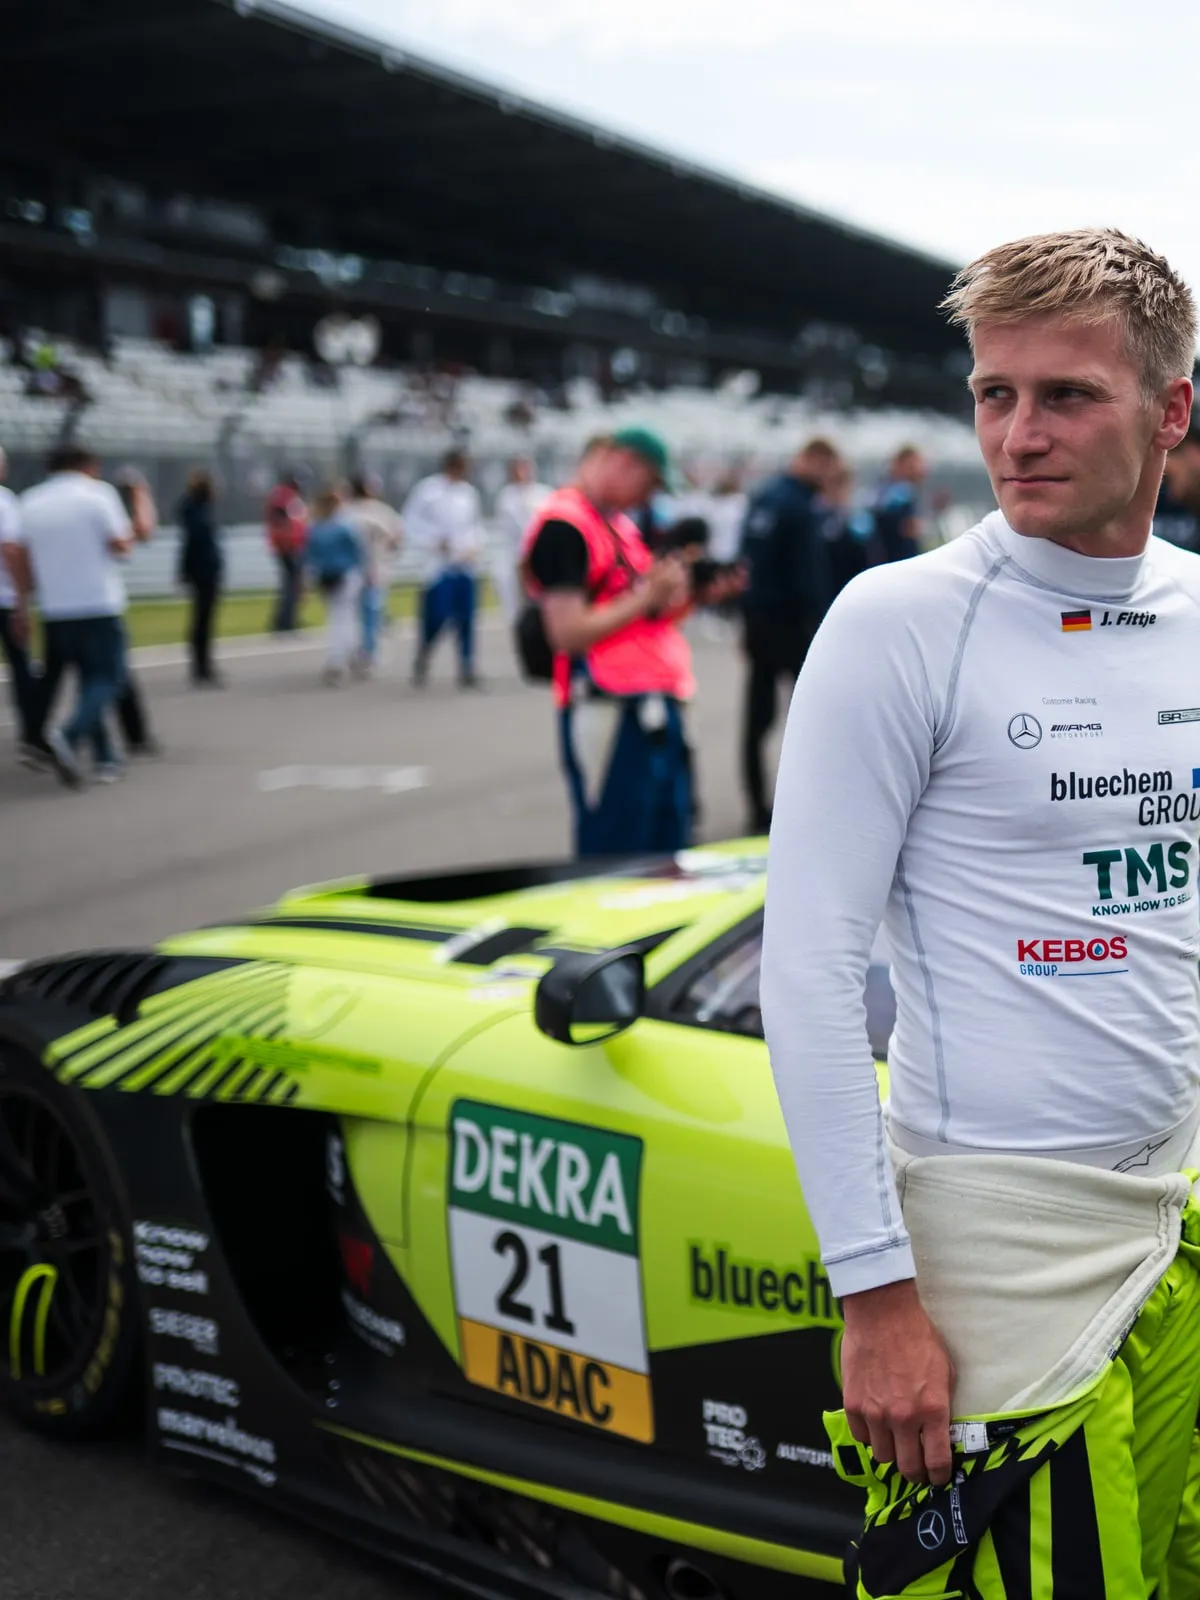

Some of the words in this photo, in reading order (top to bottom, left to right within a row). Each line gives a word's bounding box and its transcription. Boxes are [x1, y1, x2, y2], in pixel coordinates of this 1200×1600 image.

[1100, 612, 1112, 626] J.
[1116, 611, 1157, 628] Fittje
[1042, 697, 1073, 705] Customer
[1074, 696, 1098, 706] Racing
[1067, 723, 1103, 732] AMG
[1160, 713, 1182, 722] SR
[1050, 731, 1104, 740] MOTORSPORT
[1050, 768, 1173, 801] bluechem
[1082, 841, 1192, 900] TMS
[1092, 902, 1131, 917] KNOW
[1133, 898, 1161, 913] HOW
[1163, 896, 1176, 908] TO
[1017, 937, 1128, 962] KEBOS
[1019, 963, 1058, 977] GROUP
[453, 1116, 632, 1236] DEKRA
[492, 1230, 576, 1337] 21
[690, 1246, 843, 1321] bluech
[497, 1336, 613, 1427] ADAC
